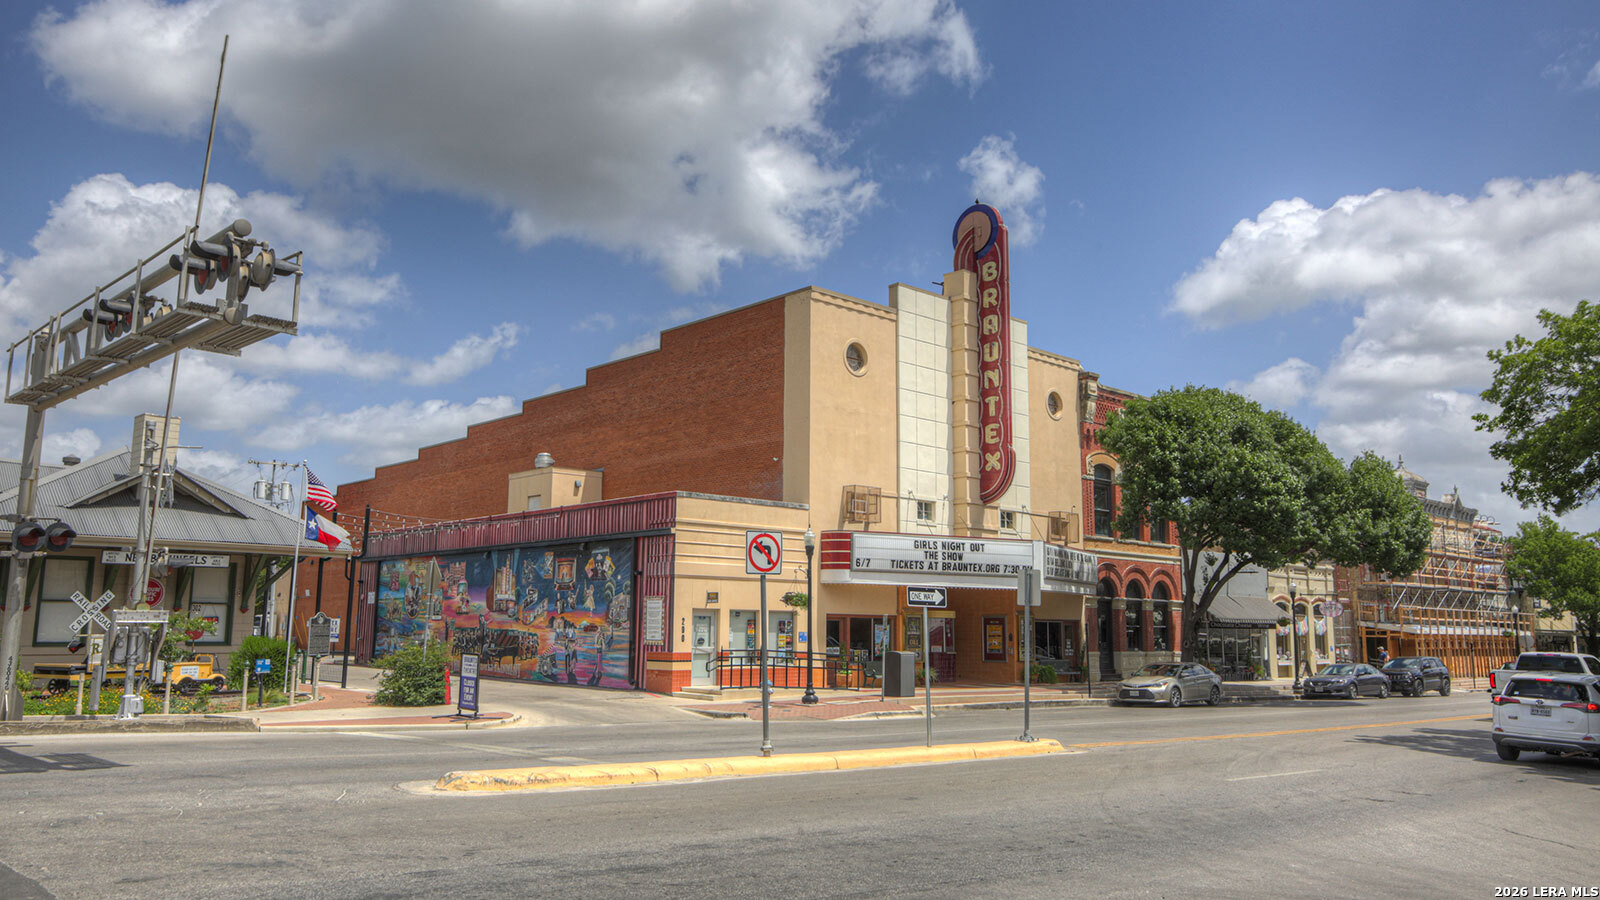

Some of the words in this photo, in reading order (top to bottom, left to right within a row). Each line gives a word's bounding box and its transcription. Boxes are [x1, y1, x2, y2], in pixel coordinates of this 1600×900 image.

[982, 261, 1001, 471] BRAUNTEX
[914, 540, 938, 550] GIRLS
[942, 541, 966, 552] NIGHT
[970, 543, 985, 552] OUT
[924, 551, 939, 560] THE
[942, 552, 964, 561] SHOW
[855, 558, 871, 568] 6/7
[891, 560, 924, 570] TICKETS
[928, 561, 939, 571] AT
[942, 563, 1000, 573] BRAUNTEX.ORG
[911, 592, 922, 600] ONE
[923, 592, 935, 601] WAY
[73, 593, 90, 610] RAIL
[94, 612, 112, 630] ROAD
